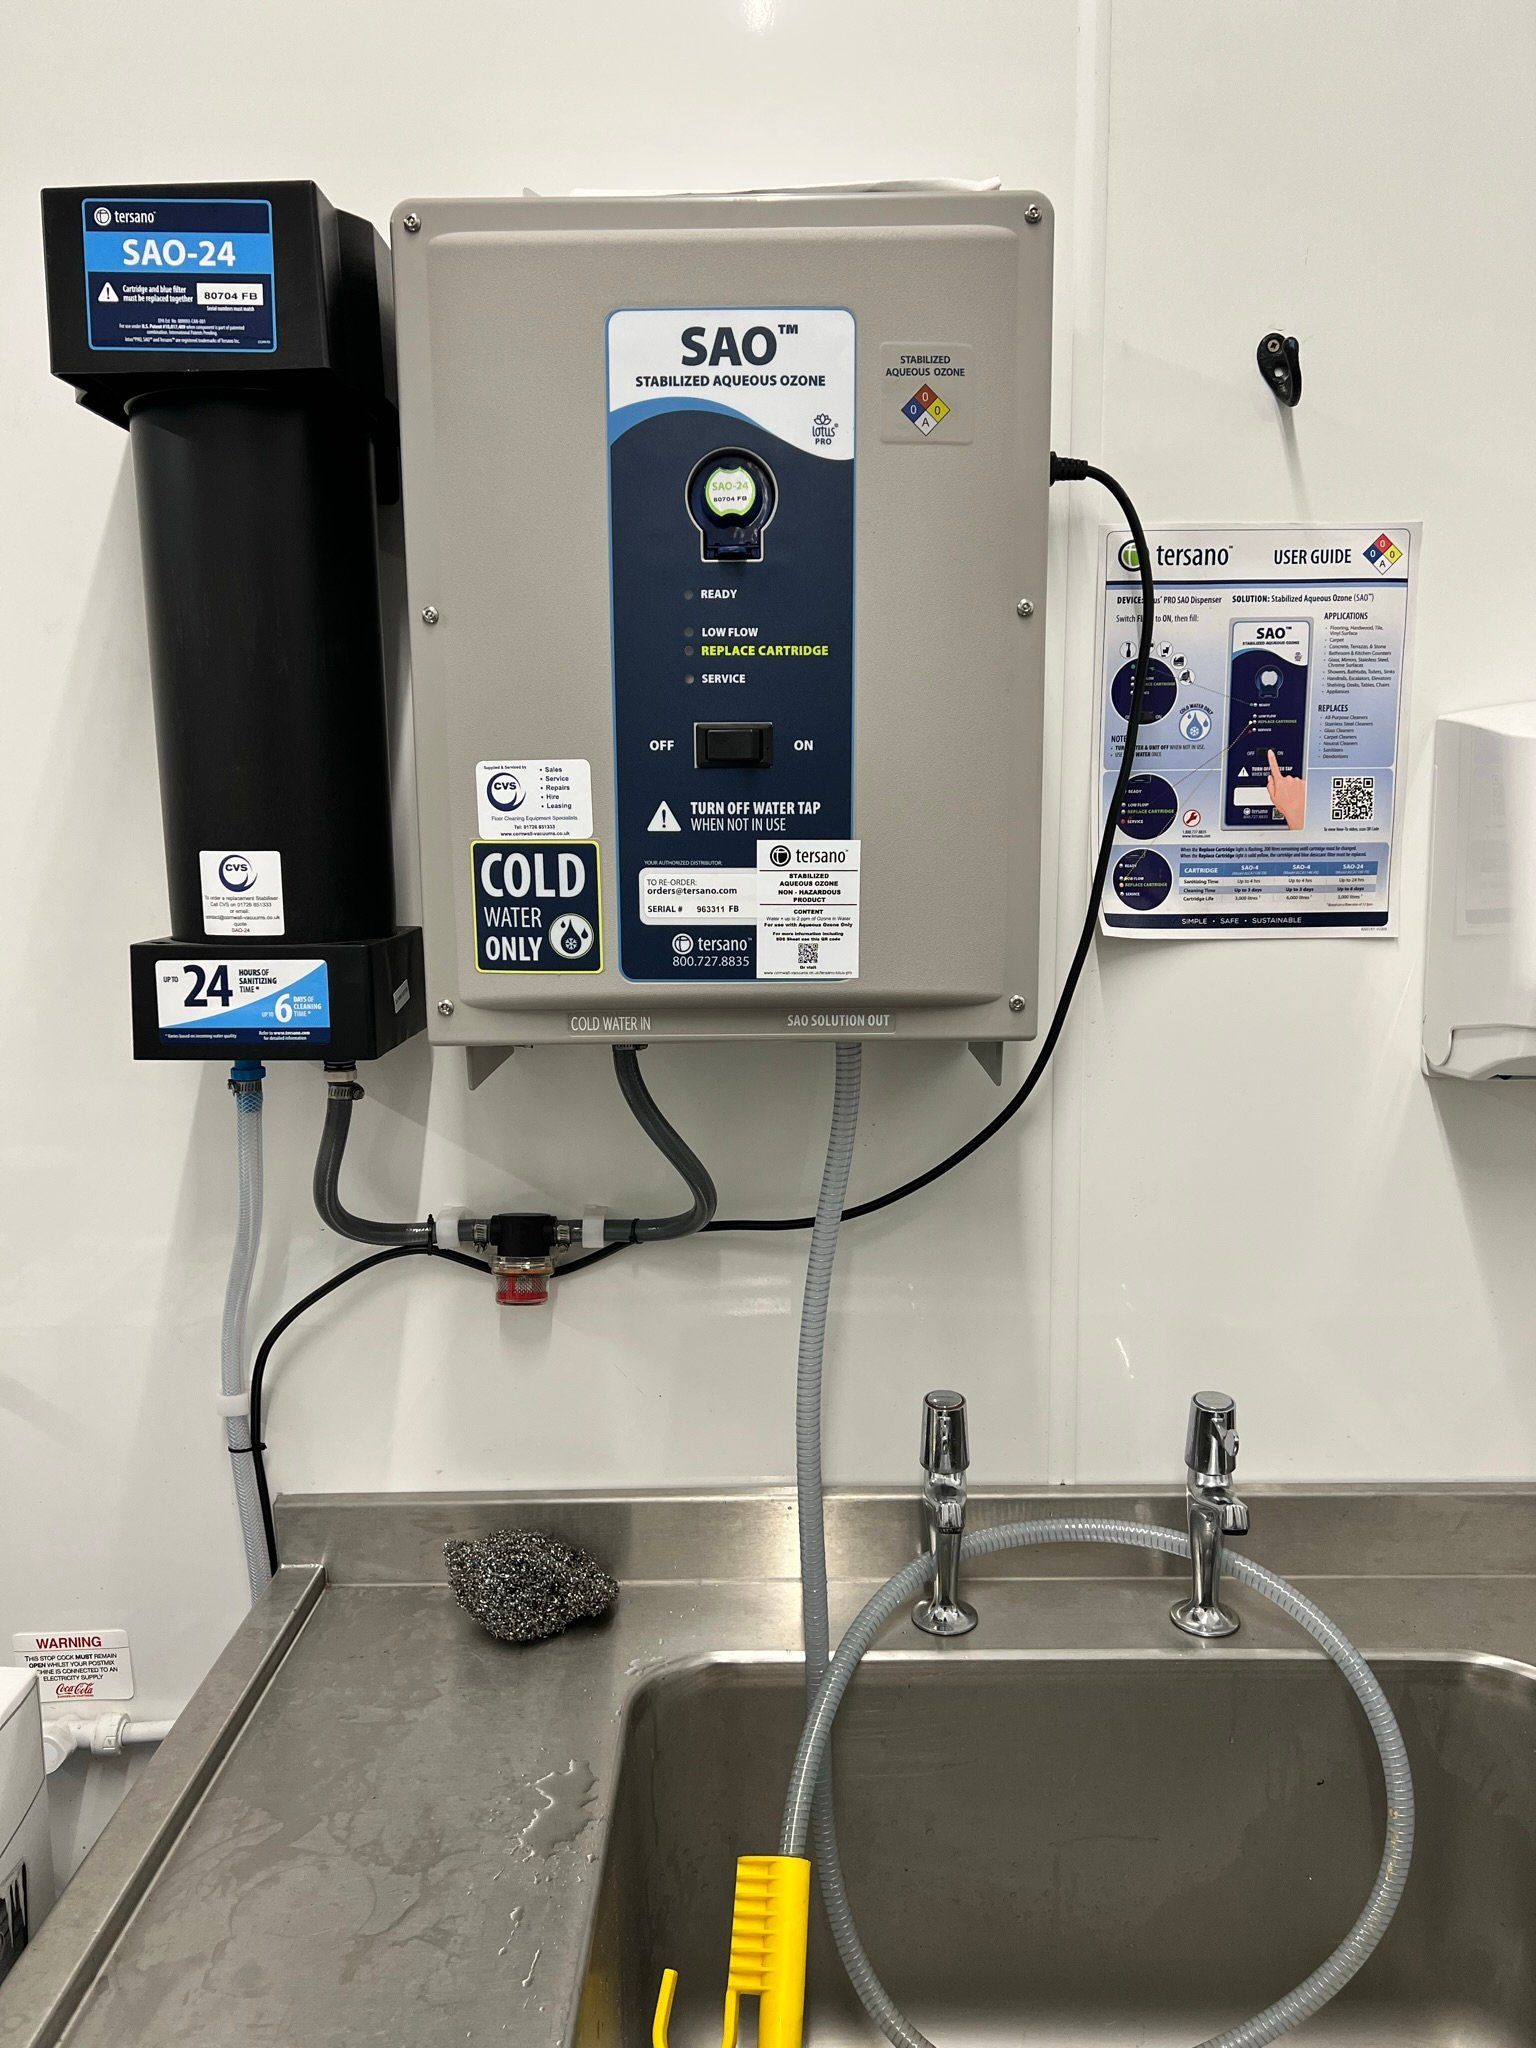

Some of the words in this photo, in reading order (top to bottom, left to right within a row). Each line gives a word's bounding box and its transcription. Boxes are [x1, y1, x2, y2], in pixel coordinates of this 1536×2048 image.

[122, 239, 236, 267] SAO-24
[123, 285, 148, 295] Cartridge
[146, 295, 169, 304] replaced
[170, 296, 193, 304] together
[901, 356, 950, 364] STABILIZED
[886, 368, 930, 377] AQUEOUS
[934, 368, 965, 376] OZONE
[636, 375, 710, 388] STABILIZED
[713, 375, 777, 388] AQUEOUS
[780, 375, 826, 387] OZONE
[922, 392, 928, 401] 0
[910, 405, 917, 414] 0
[934, 406, 940, 415] 0
[922, 418, 929, 427] A
[712, 482, 748, 491] SAO-24
[1380, 540, 1385, 548] 0
[1274, 549, 1307, 565] USER
[1310, 549, 1352, 564] GUIDE
[701, 589, 738, 599] READY
[1232, 595, 1270, 603] SOLUTION:
[1271, 594, 1302, 602] Stabilized
[1304, 594, 1331, 605] Aqueous
[1333, 594, 1352, 602] Ozone
[1190, 596, 1222, 605] Dispenser
[702, 627, 726, 637] LOW
[728, 627, 758, 637] FLOW
[701, 646, 755, 656] REPLACE
[758, 646, 829, 656] CARTRIDGE
[702, 674, 746, 684] SERVICE
[649, 740, 674, 751] OFF
[794, 740, 814, 751] ON
[691, 802, 724, 815] TURN
[727, 802, 750, 815] OFF
[753, 802, 795, 814] WATER
[798, 801, 821, 814] TAP
[691, 818, 724, 831] WHEN
[727, 818, 748, 831] NOT
[752, 818, 763, 831] IN
[766, 818, 786, 831] USE
[481, 852, 586, 898] COLD
[484, 907, 542, 928] WATER
[485, 936, 543, 961] ONLY
[672, 956, 750, 967] 800.727.8835
[183, 964, 233, 1007] 24
[274, 992, 293, 1023] 6
[571, 1016, 600, 1032] COLD
[603, 1016, 638, 1031] WATER
[640, 1016, 651, 1031] IN
[787, 1015, 808, 1027] SAO
[811, 1015, 865, 1027] SOLUTION
[868, 1014, 890, 1027] OUT
[36, 1636, 102, 1649] WARNING
